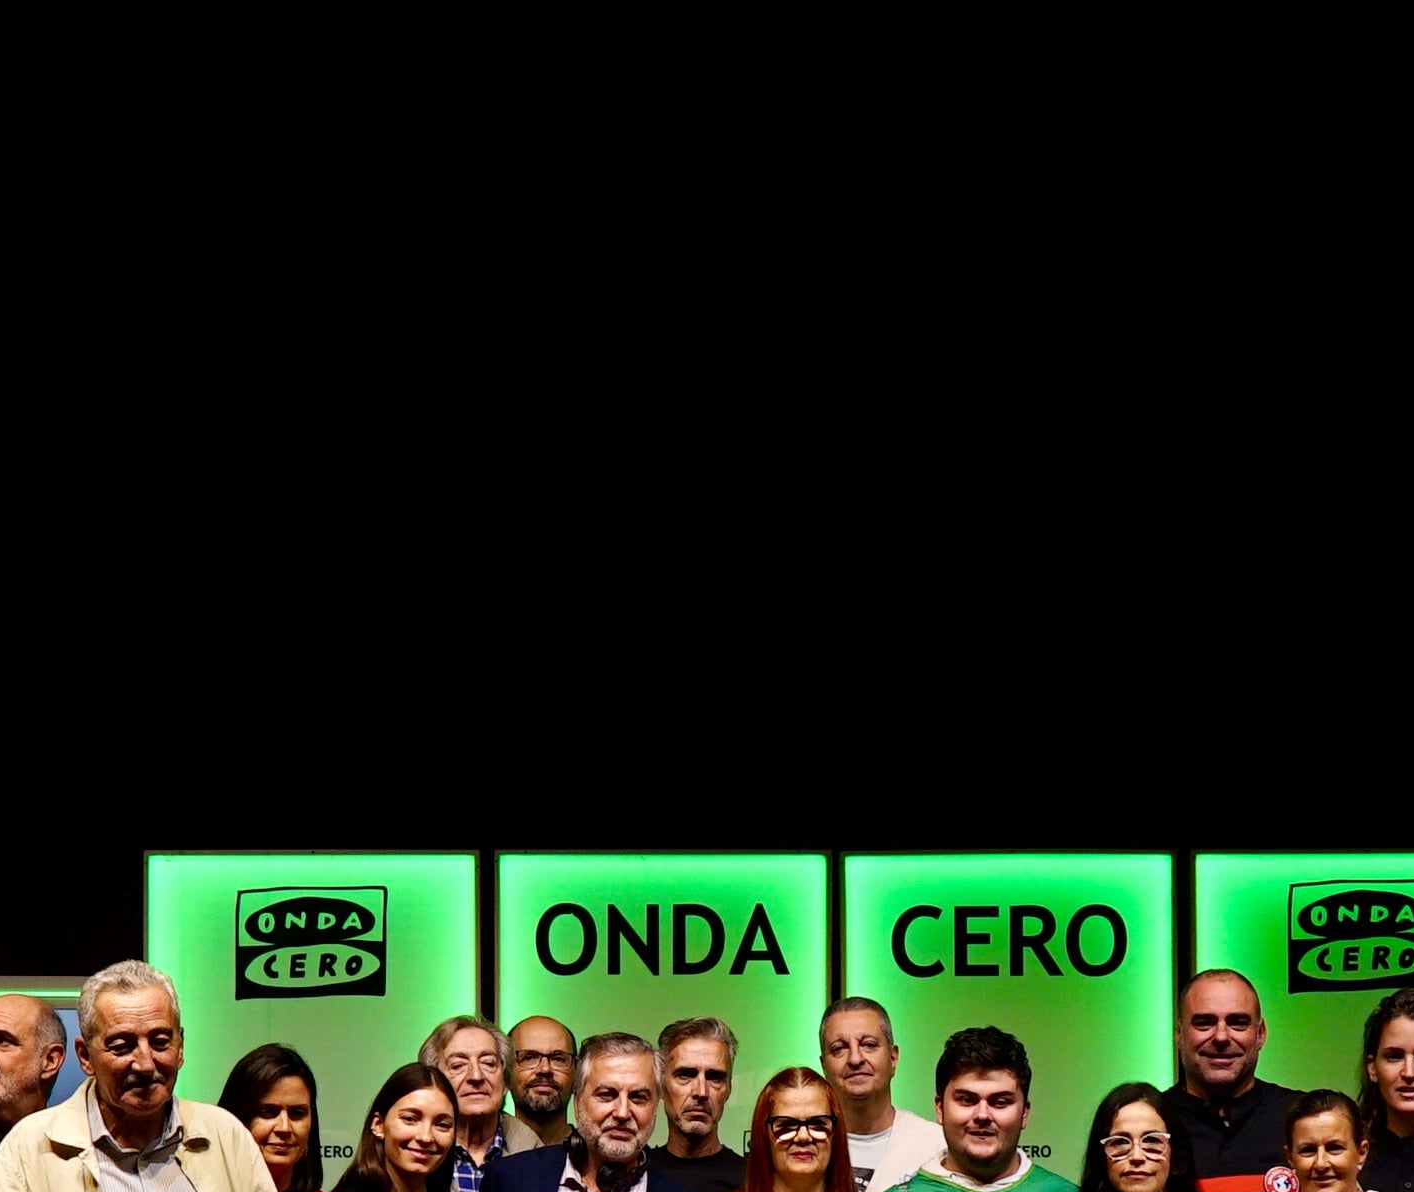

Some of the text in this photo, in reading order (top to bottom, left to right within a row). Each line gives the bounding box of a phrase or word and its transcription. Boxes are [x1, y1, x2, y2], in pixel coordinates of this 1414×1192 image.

[257, 911, 363, 934] ONDA
[535, 902, 1128, 978] ONDA CERO
[263, 953, 363, 979] CERO
[319, 1145, 353, 1158] ERO
[1017, 1145, 1051, 1158] ERO
